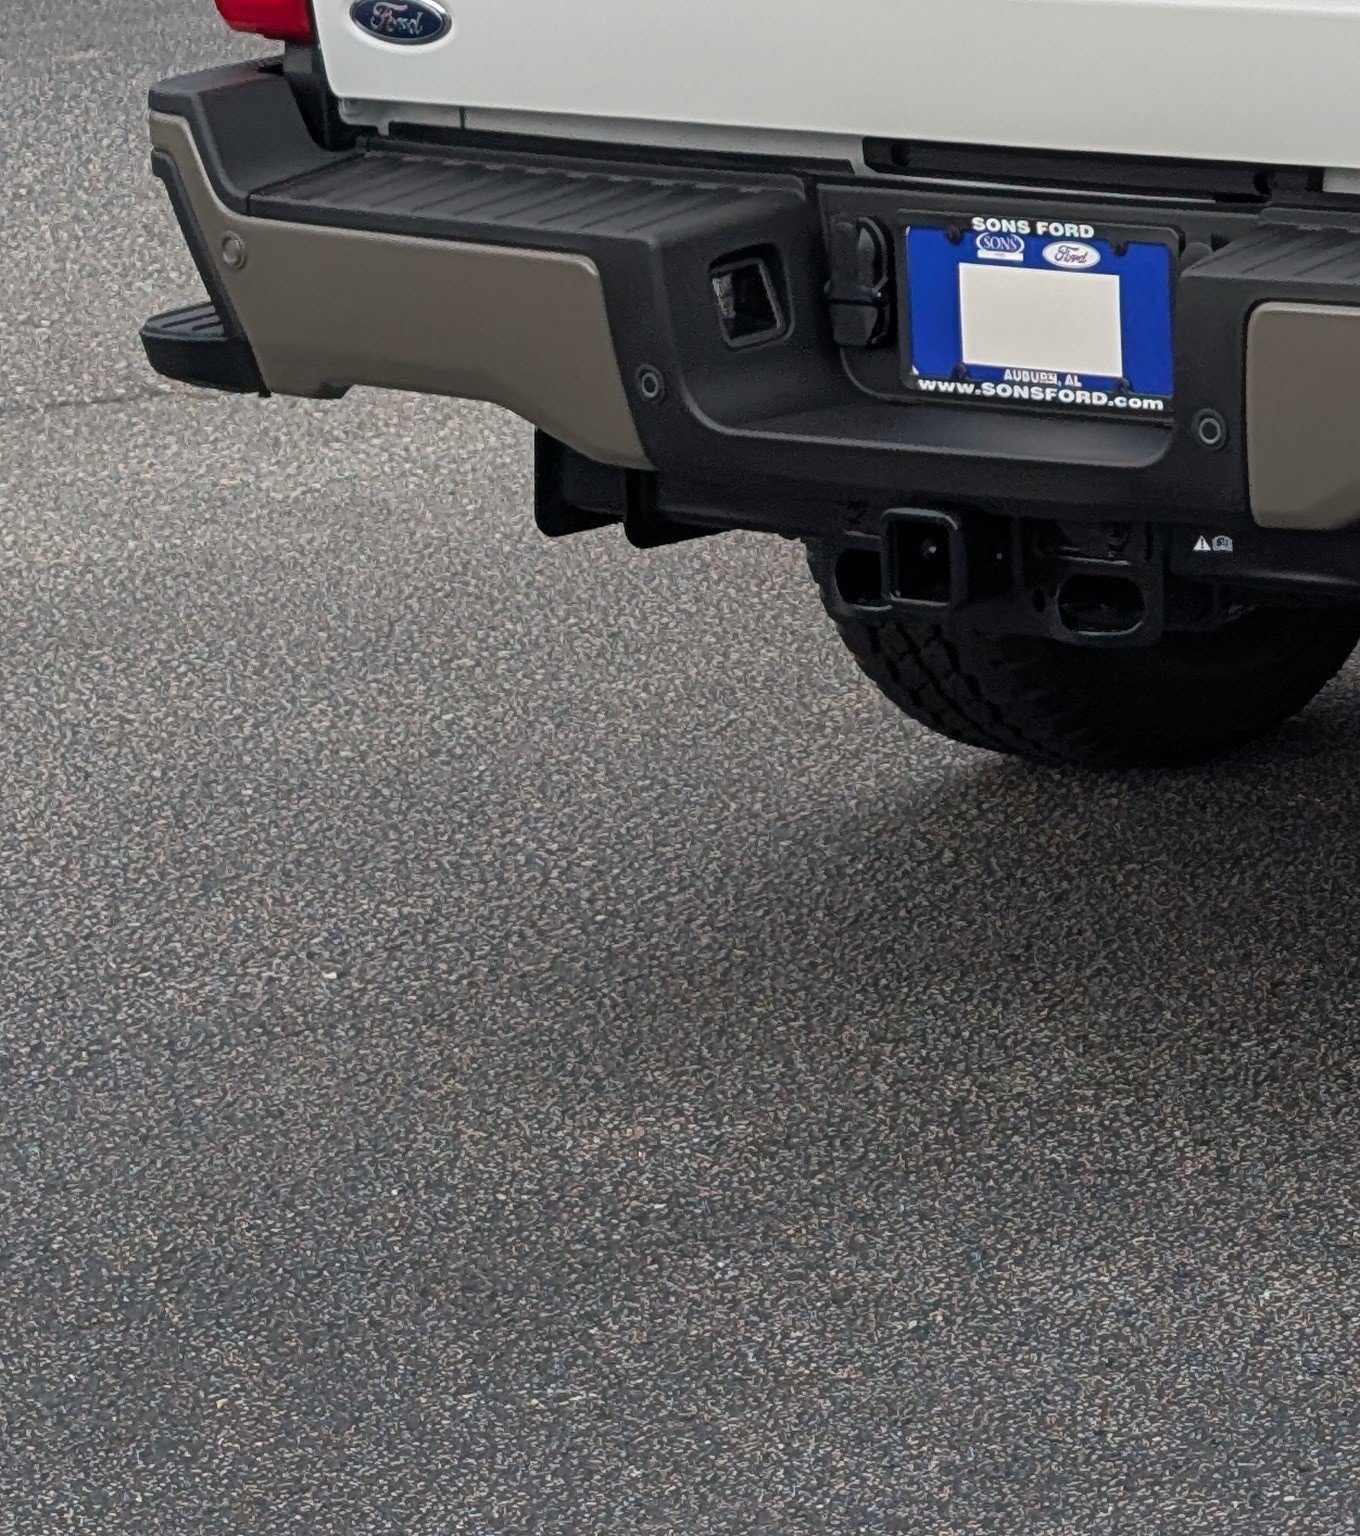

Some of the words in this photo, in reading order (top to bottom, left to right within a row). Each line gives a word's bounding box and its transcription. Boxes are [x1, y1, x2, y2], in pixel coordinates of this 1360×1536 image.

[370, 2, 424, 35] Ford
[971, 217, 1031, 234] SONS
[1036, 221, 1095, 239] FORD
[983, 236, 1018, 252] SONS
[1054, 245, 1088, 264] Ford
[1065, 372, 1083, 388] AL
[917, 378, 1164, 411] www.SONSFORD.com
